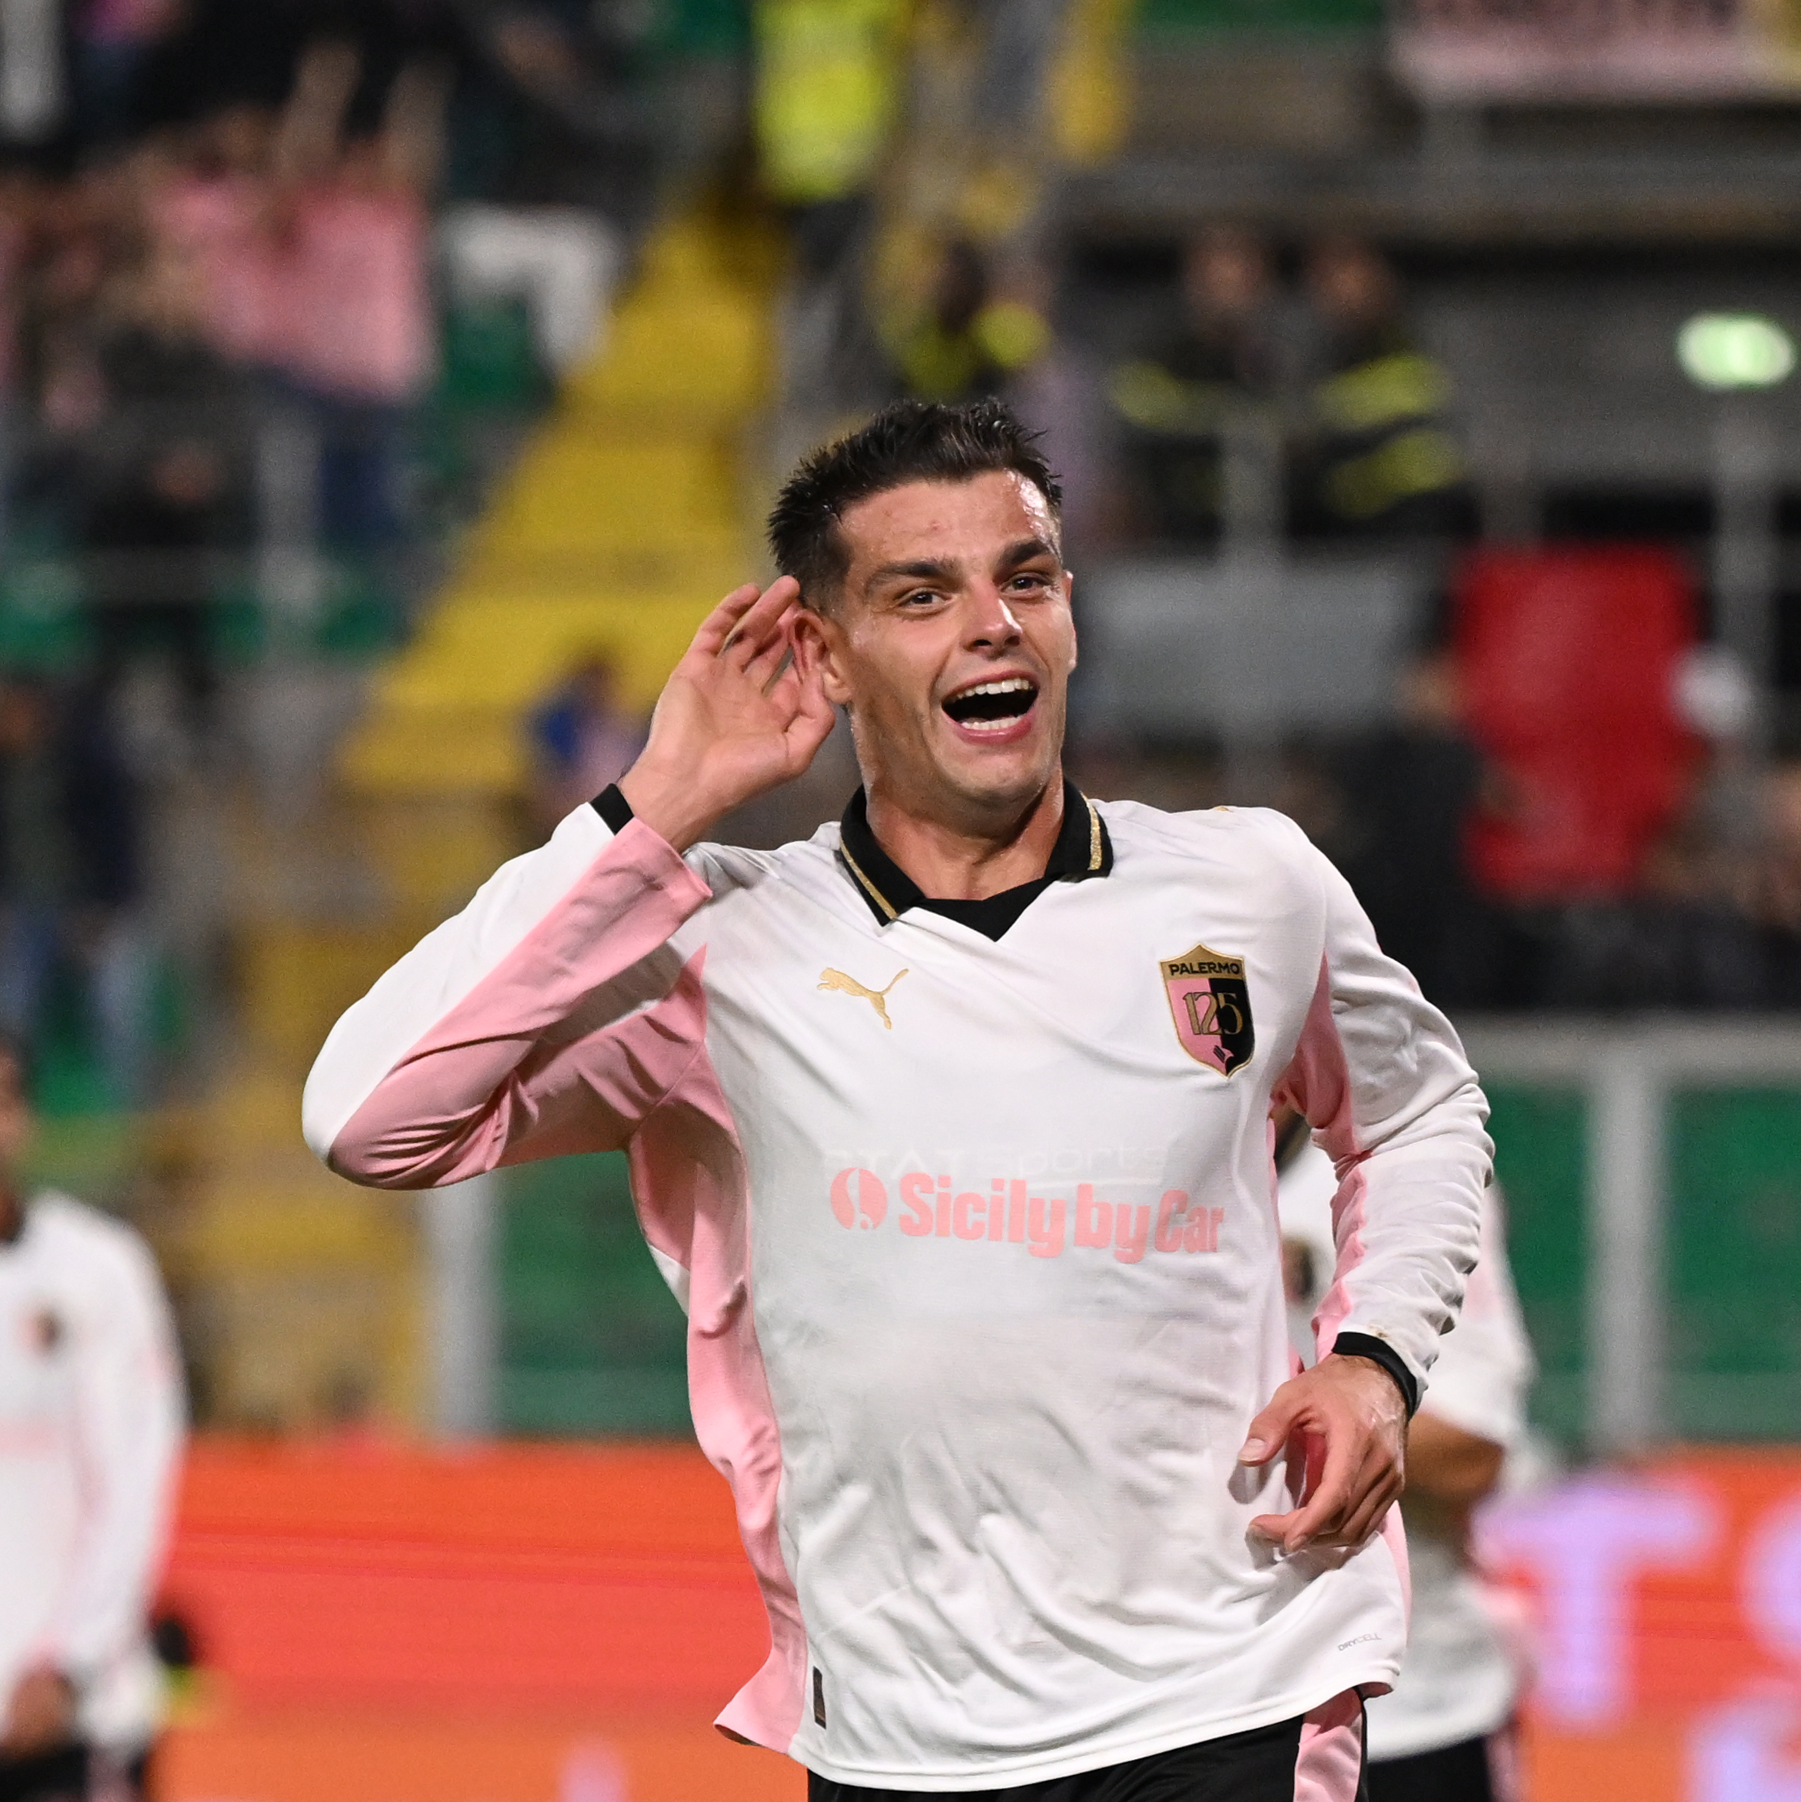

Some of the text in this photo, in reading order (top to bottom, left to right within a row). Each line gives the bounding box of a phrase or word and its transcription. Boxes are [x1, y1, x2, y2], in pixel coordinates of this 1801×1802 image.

[1168, 961, 1241, 976] PALERMO
[1182, 991, 1244, 1036] 125
[898, 1171, 1225, 1264] Sicily by Car
[1337, 1632, 1382, 1652] DRYCELL
